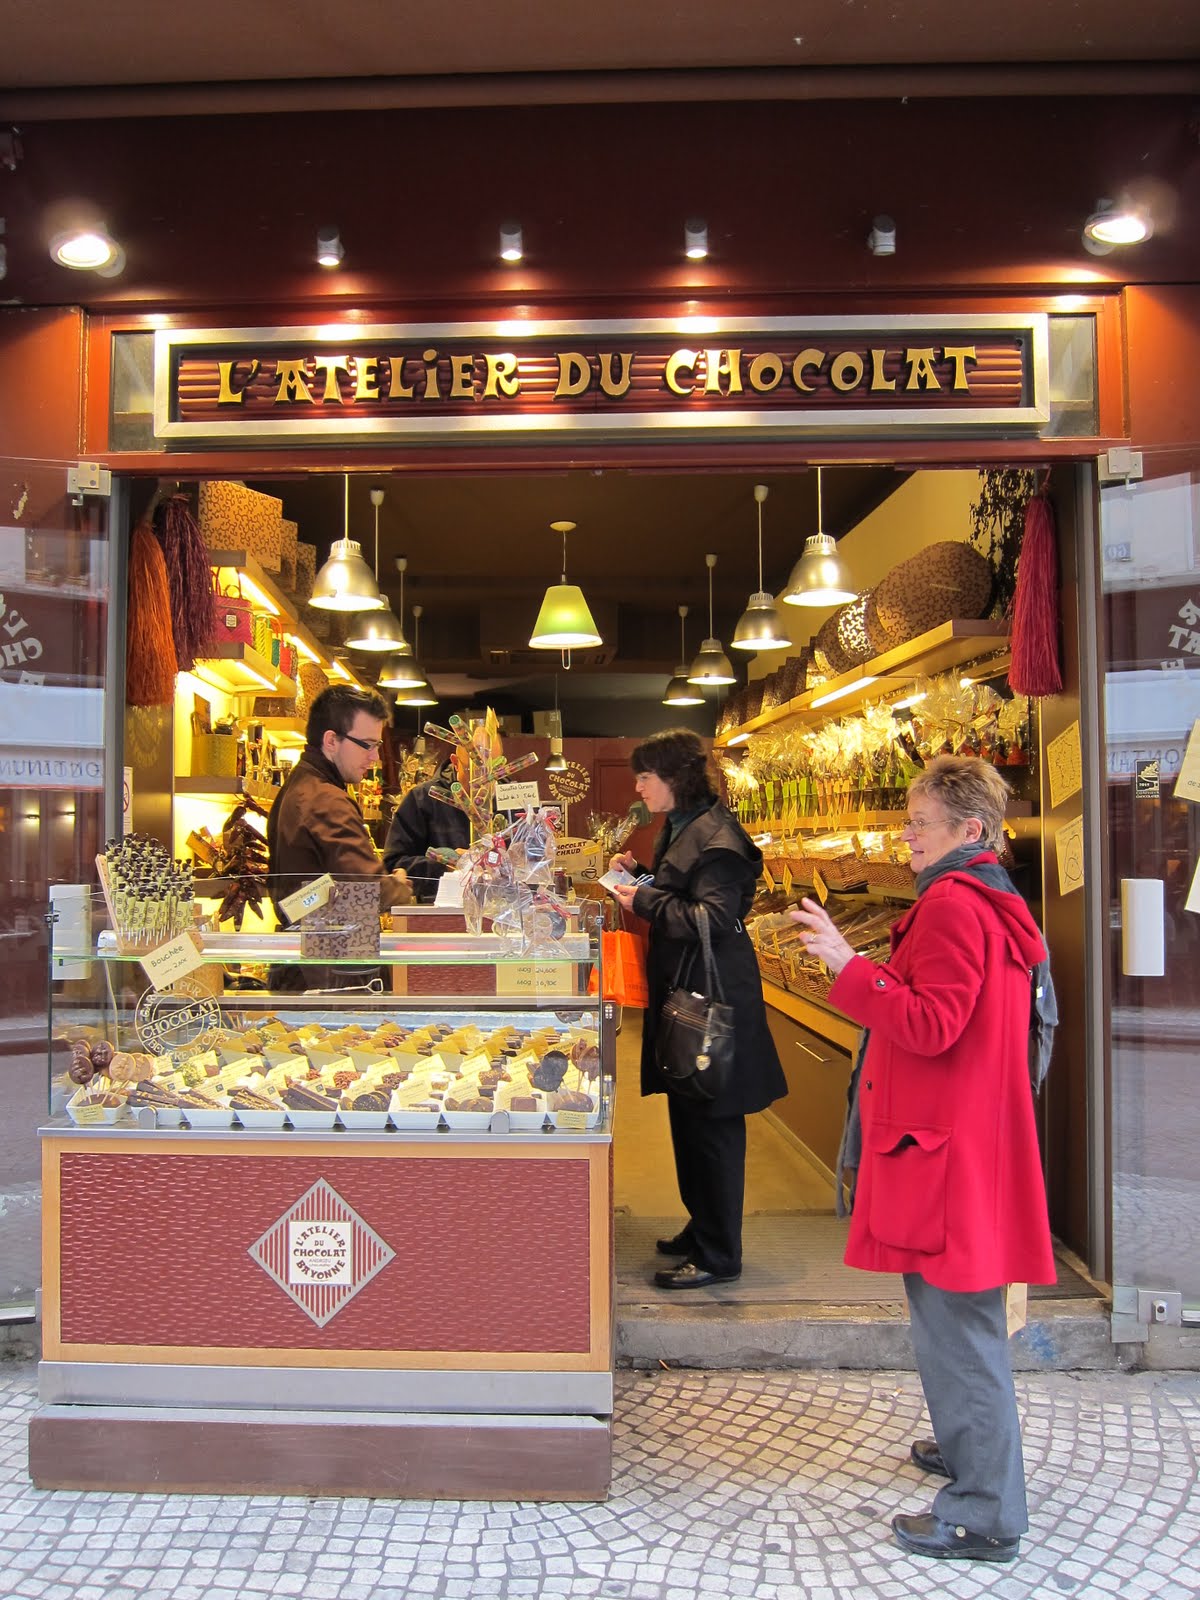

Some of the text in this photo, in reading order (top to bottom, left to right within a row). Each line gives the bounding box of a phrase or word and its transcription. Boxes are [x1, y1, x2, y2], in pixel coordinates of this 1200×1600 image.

[552, 351, 634, 400] DU
[664, 345, 978, 398] CHOCOLAT
[548, 773, 590, 792] CHOCOLAT
[566, 771, 576, 779] DU
[556, 848, 581, 856] CHAUD
[151, 944, 184, 968] Bouchée
[179, 980, 202, 997] PUR
[141, 999, 216, 1039] CHOCOLAT
[190, 1044, 206, 1057] DE
[295, 1225, 346, 1248] L'ATELIER
[293, 1248, 347, 1257] CHOCOLAT
[295, 1259, 346, 1280] BAYONNE
